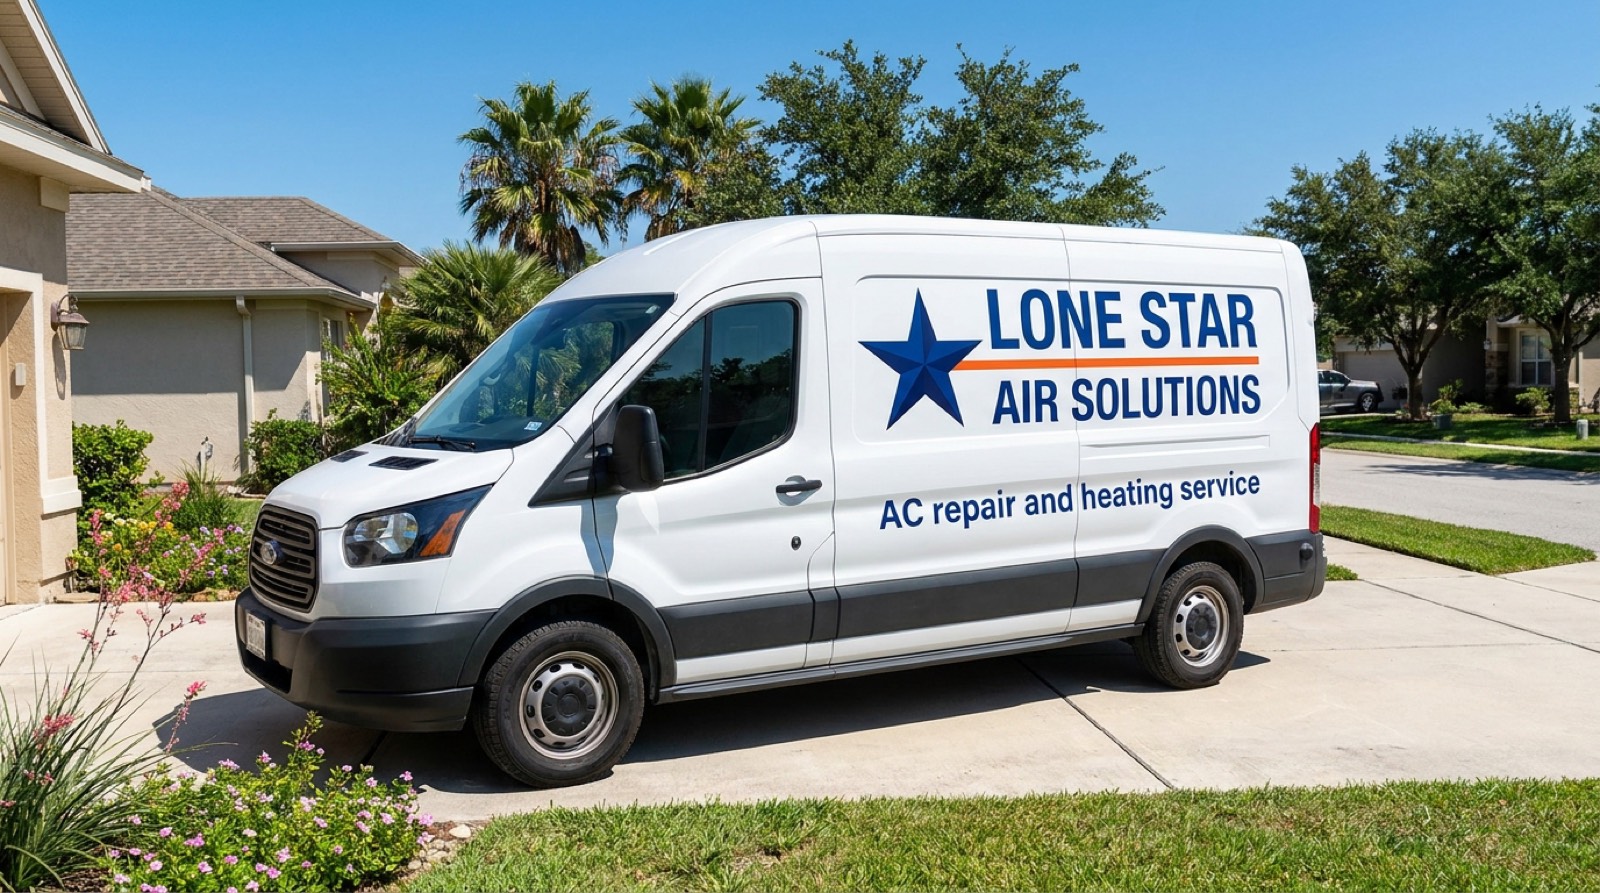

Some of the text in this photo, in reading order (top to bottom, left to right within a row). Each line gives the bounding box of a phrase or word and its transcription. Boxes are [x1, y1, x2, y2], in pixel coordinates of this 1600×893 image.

[986, 288, 1258, 350] LONE STAR
[992, 374, 1261, 425] AIR SOLUTIONS
[879, 470, 1260, 530] AC repair and heating service
